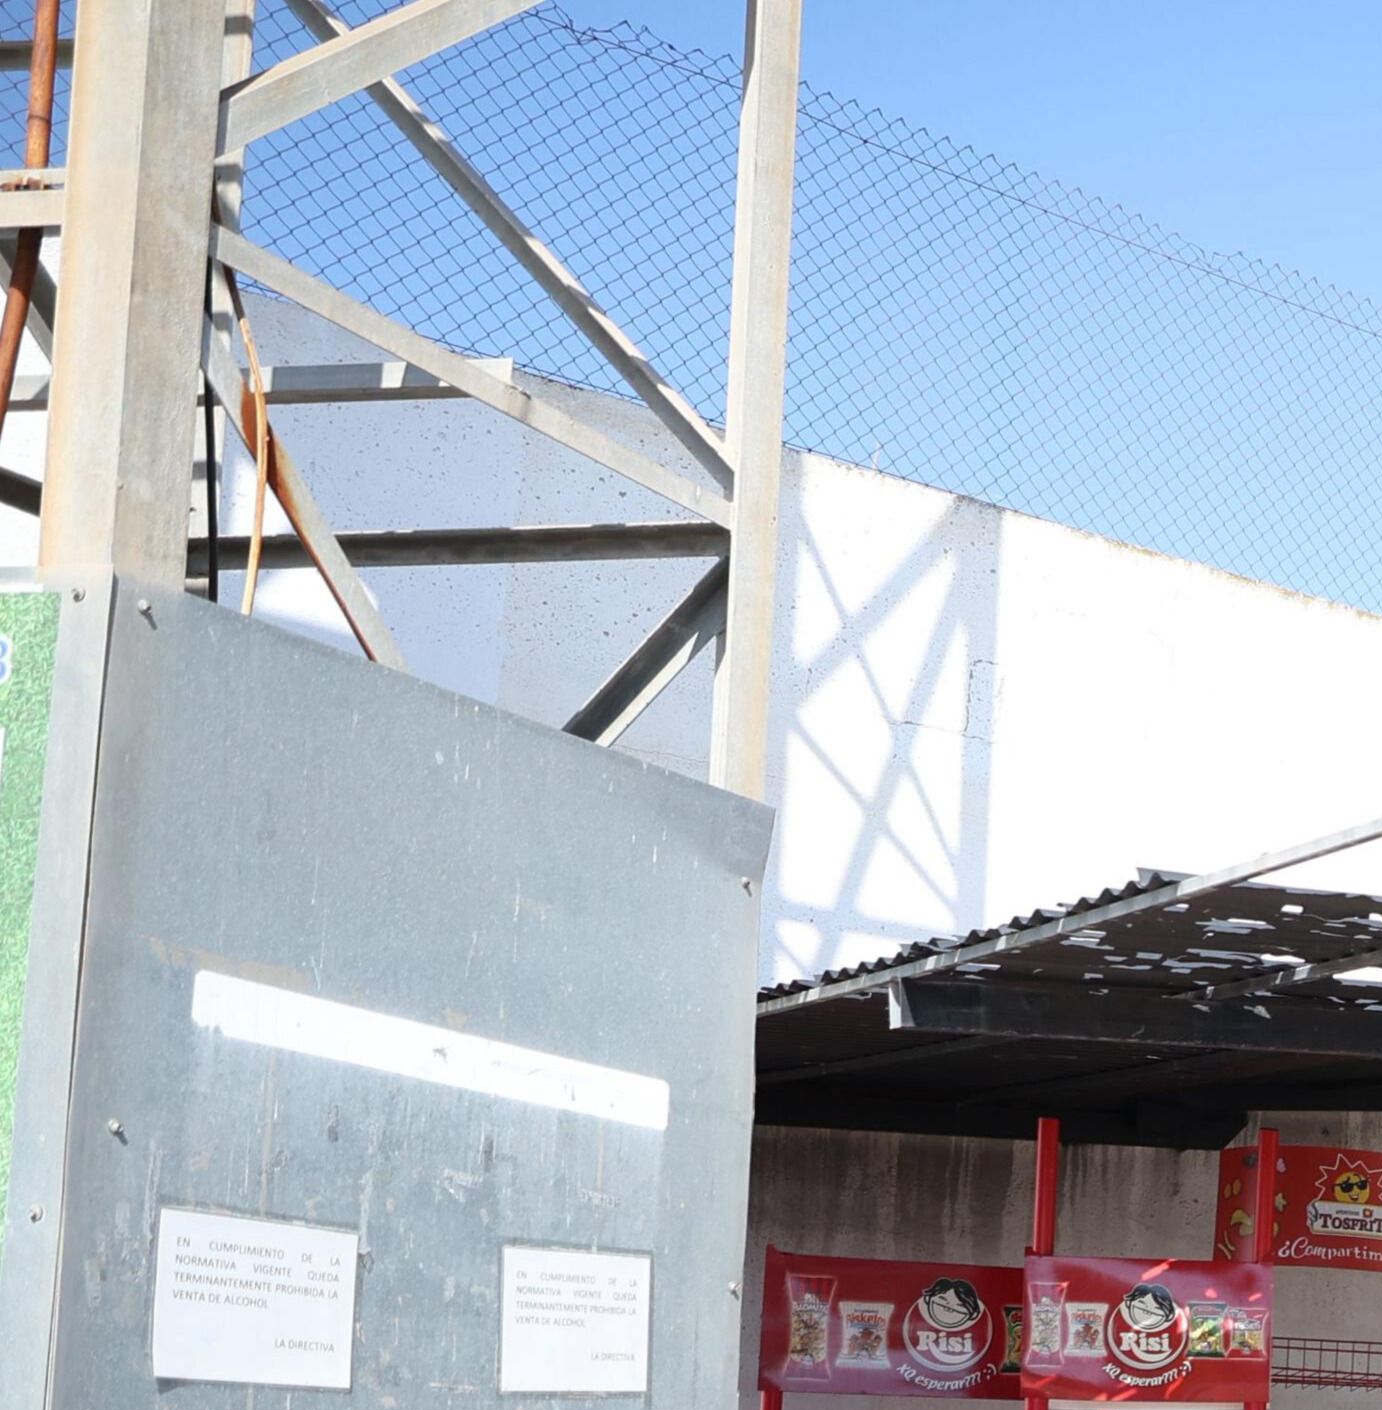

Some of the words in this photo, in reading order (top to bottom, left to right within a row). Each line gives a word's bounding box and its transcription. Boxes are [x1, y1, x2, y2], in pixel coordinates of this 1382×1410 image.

[176, 1236, 190, 1248] EN
[209, 1241, 285, 1260] CUMPLIMIENTO
[301, 1253, 313, 1264] DE
[330, 1256, 341, 1266] LA
[175, 1254, 237, 1271] NORMATIVA
[253, 1263, 292, 1277] VIGENTE
[307, 1271, 340, 1283] QUEDA
[174, 1271, 272, 1292] TERMINANTEMENTE
[275, 1284, 325, 1298] PROHIBIDA
[328, 1289, 339, 1300] LA
[516, 1286, 561, 1296] NORMATIVA
[172, 1289, 206, 1302] VENTA
[208, 1293, 221, 1304] DE
[224, 1296, 269, 1309] ALCOHOL
[274, 1339, 286, 1349] LA
[288, 1340, 335, 1352] DIRECTIVA
[916, 1331, 973, 1354] Risi
[1119, 1331, 1172, 1353] Risi
